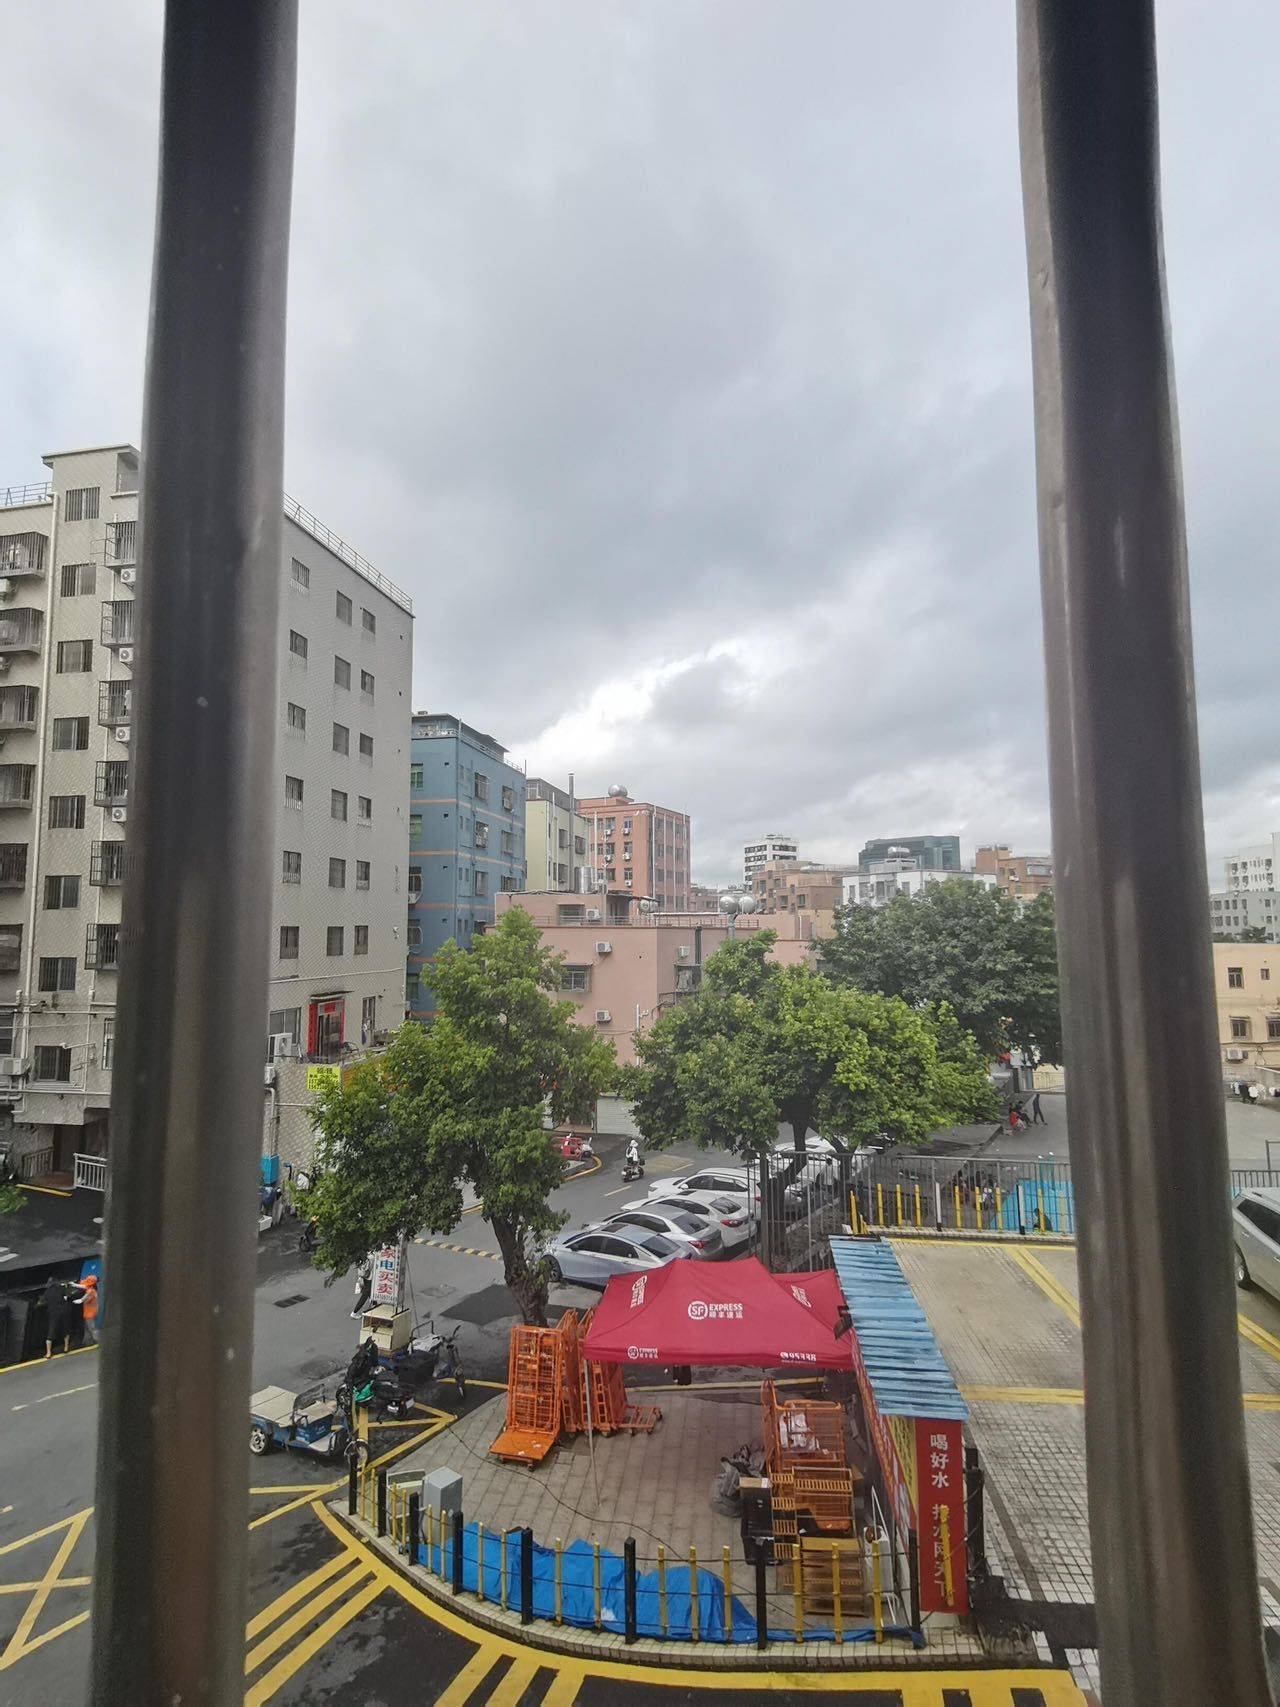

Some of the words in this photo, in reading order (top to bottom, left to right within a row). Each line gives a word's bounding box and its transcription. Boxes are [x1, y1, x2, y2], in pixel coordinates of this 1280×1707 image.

[709, 1303, 743, 1311] EXPRESS
[930, 1434, 950, 1489] 喝好水
